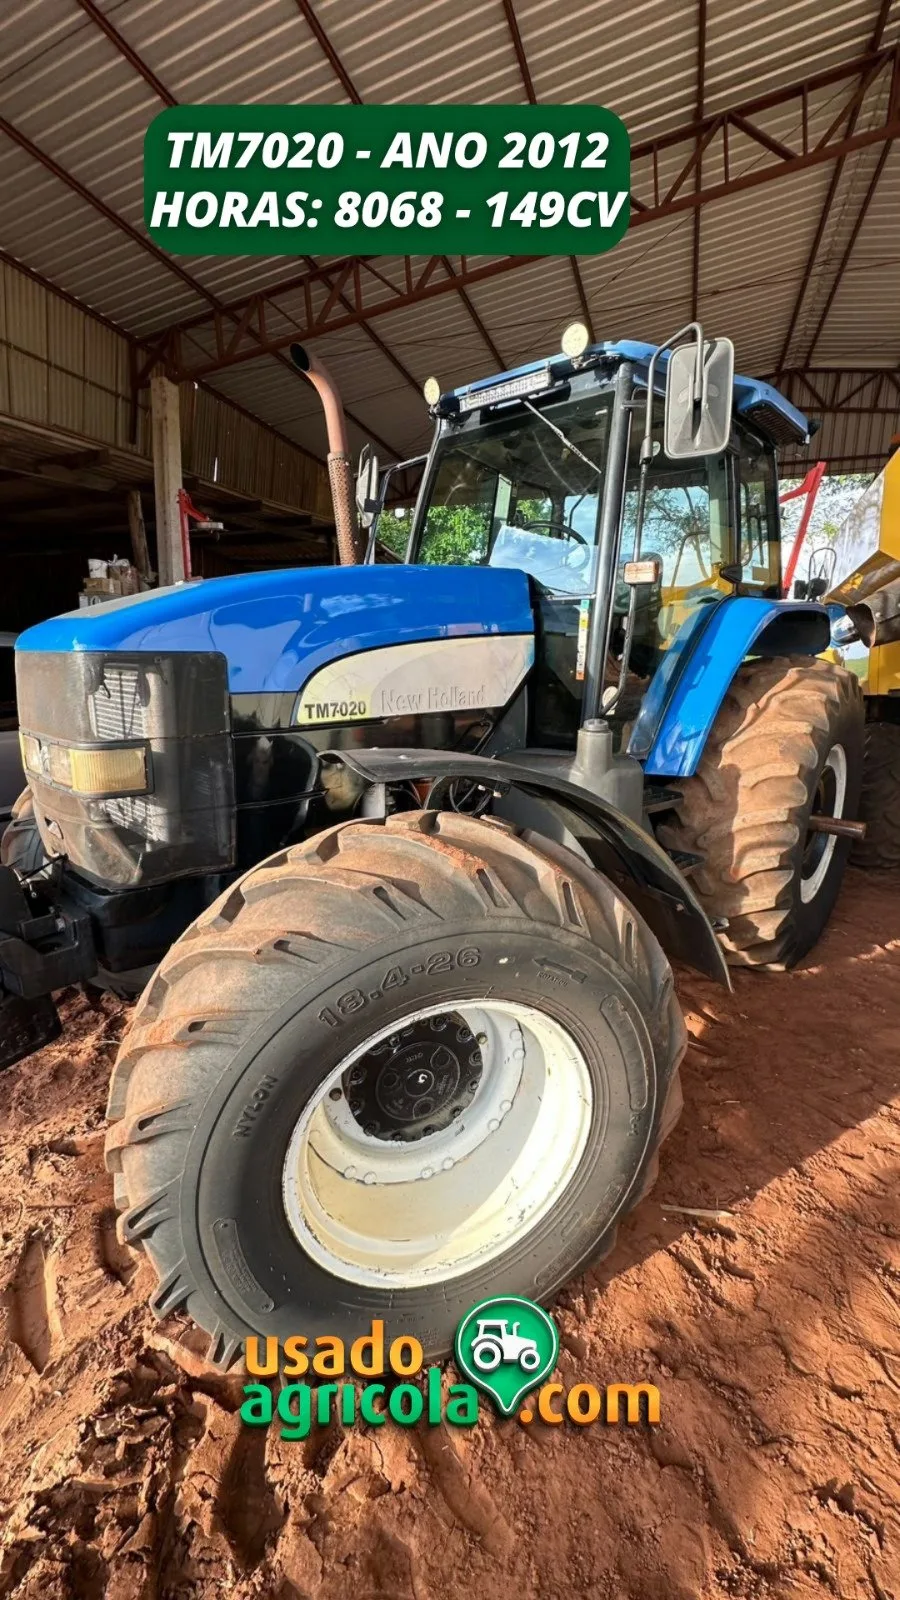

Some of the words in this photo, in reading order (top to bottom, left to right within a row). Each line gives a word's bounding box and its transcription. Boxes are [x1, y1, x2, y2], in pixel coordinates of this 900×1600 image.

[304, 700, 367, 720] TM7020
[380, 689, 423, 713] New
[428, 685, 486, 709] Holland
[232, 1074, 279, 1138] NYLON
